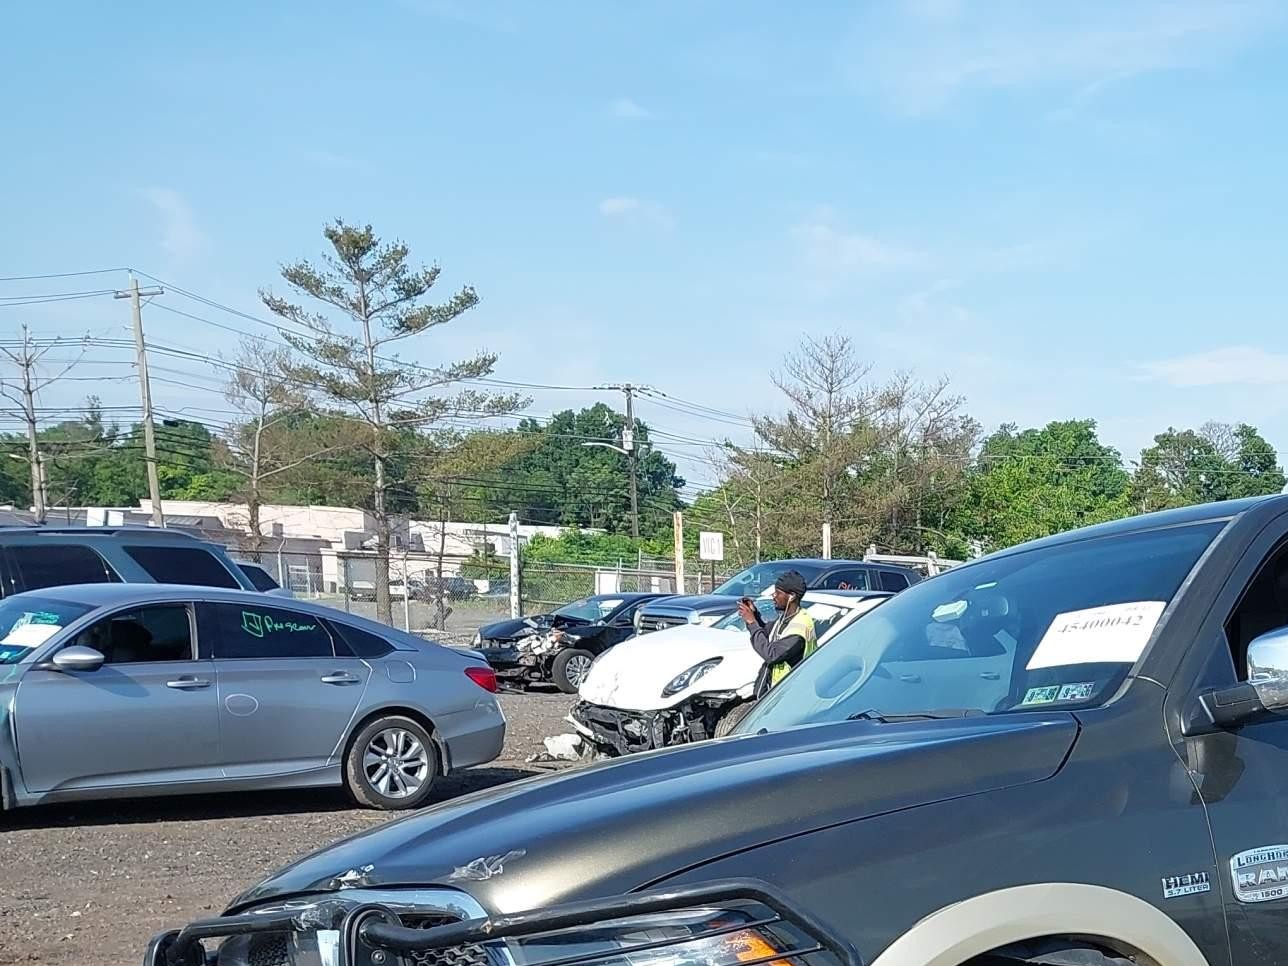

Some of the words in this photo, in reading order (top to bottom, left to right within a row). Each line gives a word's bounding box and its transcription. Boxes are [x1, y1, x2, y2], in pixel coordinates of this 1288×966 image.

[1057, 615, 1144, 633] 45400042
[1162, 871, 1209, 890] HEMI
[1168, 889, 1181, 897] 5.7
[1184, 884, 1209, 894] LITER
[1261, 888, 1283, 898] 1500
